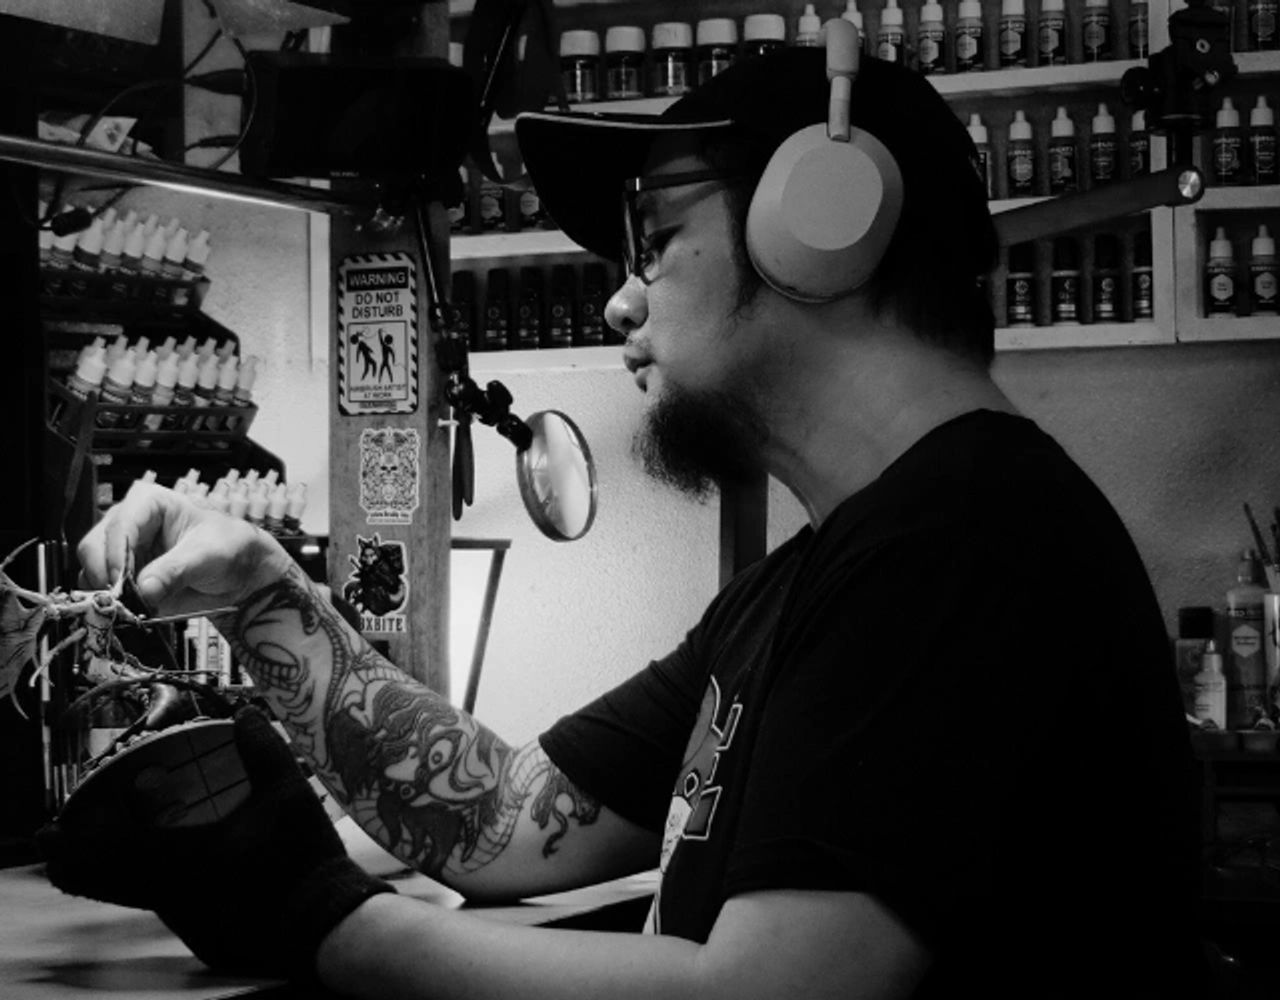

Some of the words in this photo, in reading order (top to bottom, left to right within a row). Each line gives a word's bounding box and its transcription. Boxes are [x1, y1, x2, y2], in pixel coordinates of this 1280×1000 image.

[349, 272, 406, 286] WARNING
[355, 293, 372, 305] DO
[376, 292, 399, 303] NOT
[352, 305, 403, 319] DISTURB
